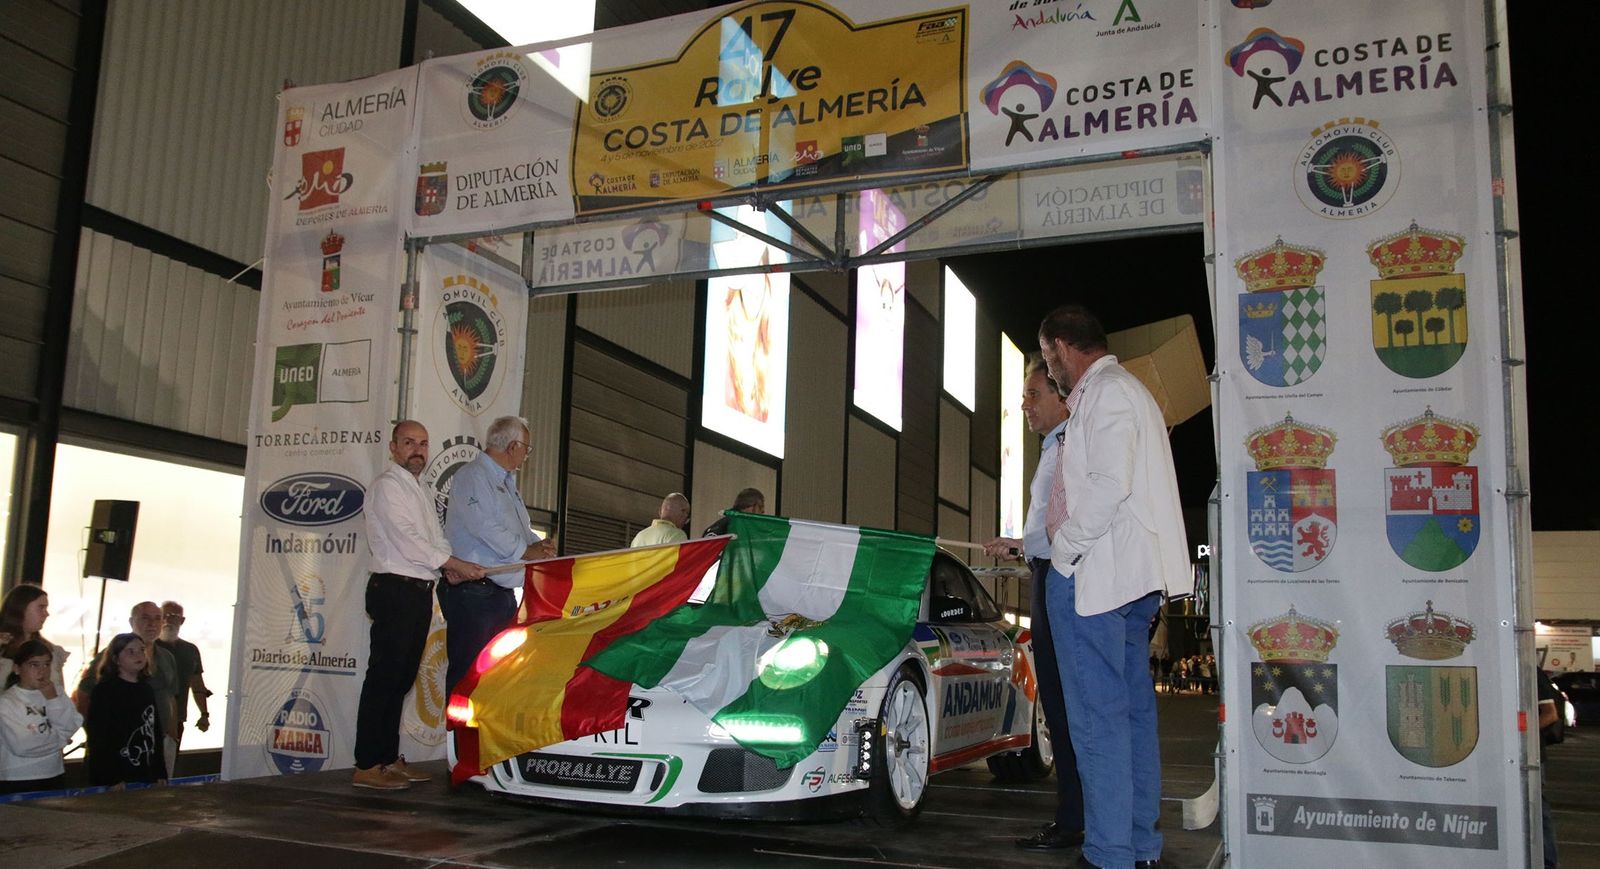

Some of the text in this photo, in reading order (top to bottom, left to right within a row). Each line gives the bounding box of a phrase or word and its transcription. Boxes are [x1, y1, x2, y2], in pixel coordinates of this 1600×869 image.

[1012, 3, 1096, 31] Andalucía
[1096, 30, 1116, 38] Junta
[1126, 21, 1161, 33] Andalucía
[719, 8, 797, 65] 47
[1314, 32, 1452, 67] COSTA DE
[1066, 68, 1194, 106] COSTA DE
[1288, 55, 1458, 107] ALMERÍA
[321, 86, 407, 122] ALMERÍA
[603, 78, 927, 152] COSTA DE ALMERÍA
[1038, 92, 1198, 143] ALMERÍA
[319, 119, 363, 137] CIUDAD
[1301, 127, 1396, 167] AUTOMOVIL CLUB
[456, 158, 559, 191] DIPUTACIÓN
[456, 178, 557, 210] DE ALMERÍA
[1320, 201, 1378, 217] ALMERIA
[490, 311, 505, 347] CLUB
[280, 366, 314, 383] UNED
[255, 426, 382, 448] TORRECÁRDENAS
[281, 481, 346, 516] Ford
[266, 532, 357, 554] Indamóvil
[252, 648, 357, 669] Diario de Almería
[942, 680, 1003, 719] ANDAMUR
[280, 710, 318, 726] RADIO
[273, 728, 324, 754] MARCA
[525, 758, 635, 781] PRORALLYE
[1293, 805, 1488, 840] Ayuntamiento de Níjar
